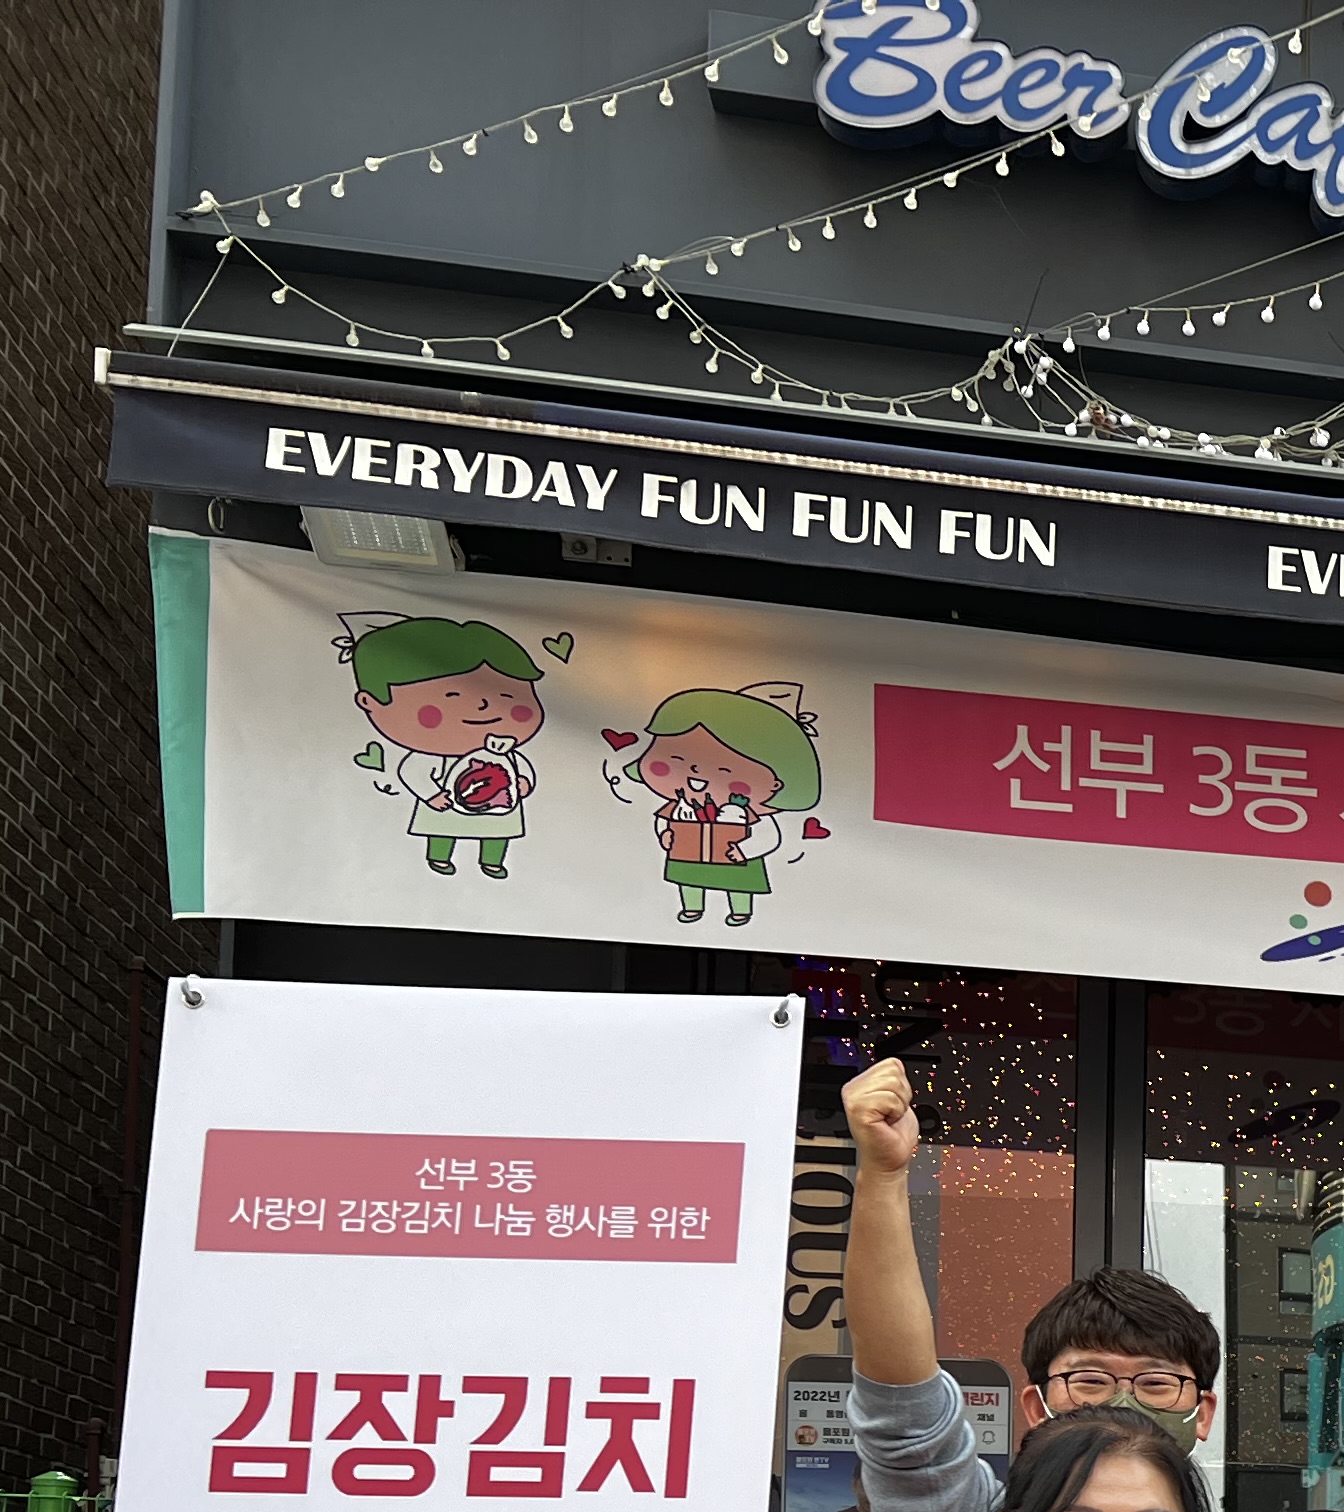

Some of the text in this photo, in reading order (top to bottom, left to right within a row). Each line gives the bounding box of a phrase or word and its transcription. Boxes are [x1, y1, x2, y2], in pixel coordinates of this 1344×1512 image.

[820, 0, 1124, 133] Beer
[264, 427, 1058, 567] EVERYDAY FUN FUN FUN
[993, 725, 1165, 819] 선부
[1188, 745, 1320, 833] 3동
[228, 1197, 712, 1241] 사랑의 김장김치 나눔 행사를 위한
[413, 1158, 538, 1193] 선부 3동
[204, 1369, 697, 1499] 김장김치
[793, 1390, 841, 1403] 2022년
